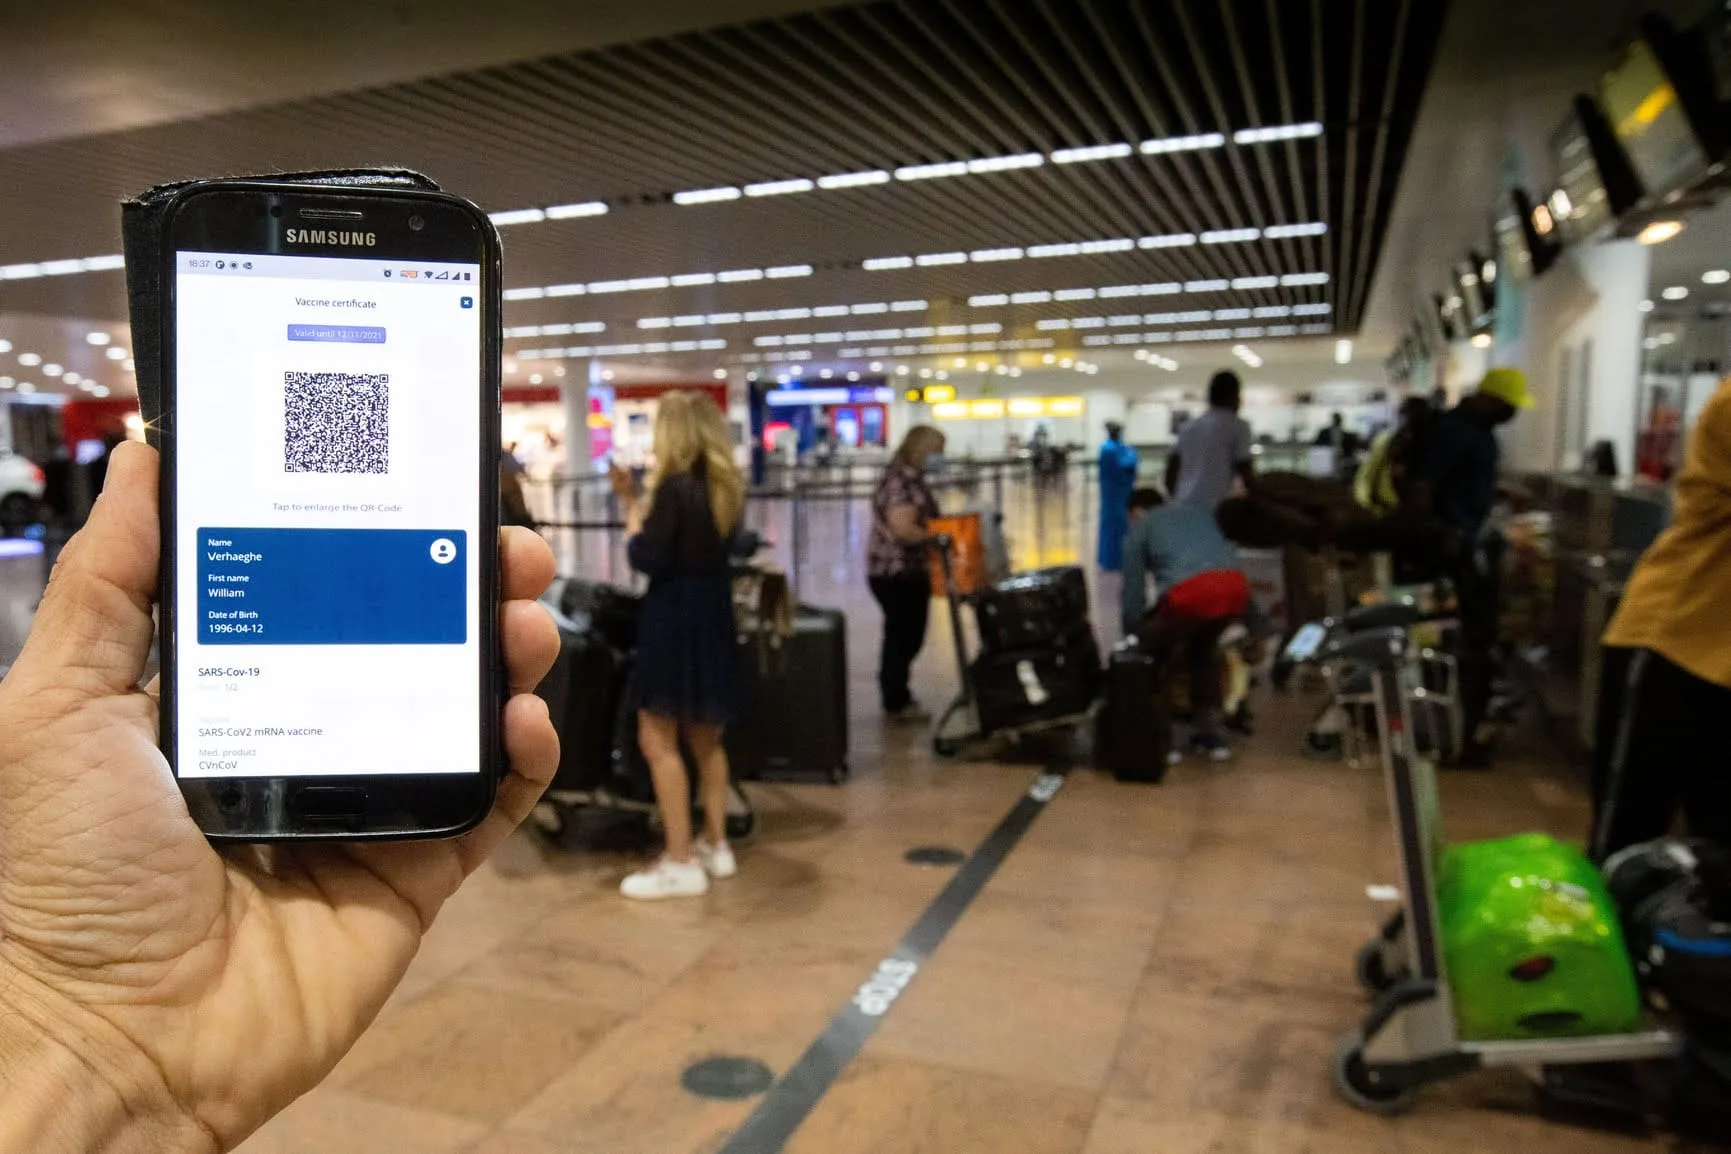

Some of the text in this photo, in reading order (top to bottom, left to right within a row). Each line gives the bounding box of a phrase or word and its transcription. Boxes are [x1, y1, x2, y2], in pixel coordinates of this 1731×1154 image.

[287, 229, 376, 246] SAMSUNG
[295, 297, 377, 309] Vaccine certificate
[294, 328, 314, 338] Valid
[316, 329, 335, 338] until
[273, 503, 402, 513] Tap to enlarge the QR-Code
[208, 538, 232, 547] Name
[207, 551, 263, 564] Verhaeghe
[208, 574, 226, 582] First
[208, 588, 245, 598] William
[208, 610, 258, 619] Date of Birth
[209, 624, 263, 634] 1996-04-12
[198, 667, 260, 677] SARS-Cov-19
[224, 683, 239, 692] 1/2
[198, 727, 323, 737] SARS-CoV2 mRNA vaccine
[222, 747, 257, 758] product
[198, 760, 238, 770] CVnCoV
